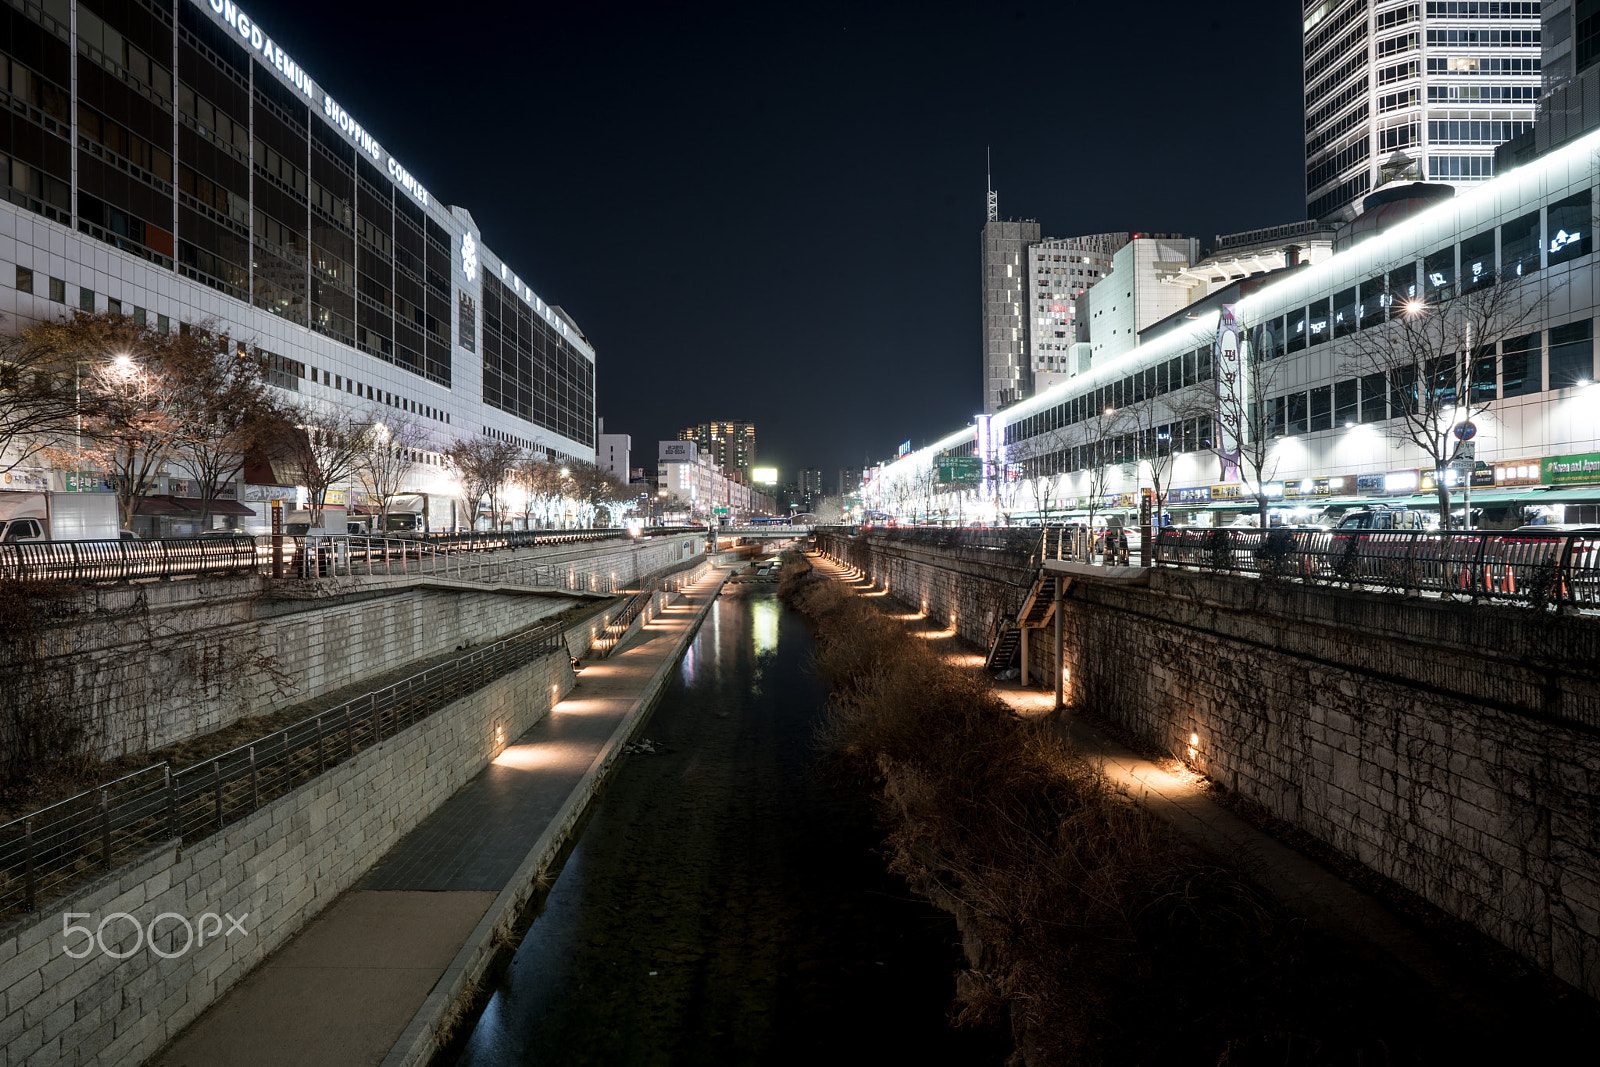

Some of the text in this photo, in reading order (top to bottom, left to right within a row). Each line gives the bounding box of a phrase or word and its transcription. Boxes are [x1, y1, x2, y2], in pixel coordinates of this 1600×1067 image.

[325, 96, 380, 160] SHOPPING
[388, 157, 428, 206] COMPLEX
[1553, 459, 1600, 473] Korea and Japan
